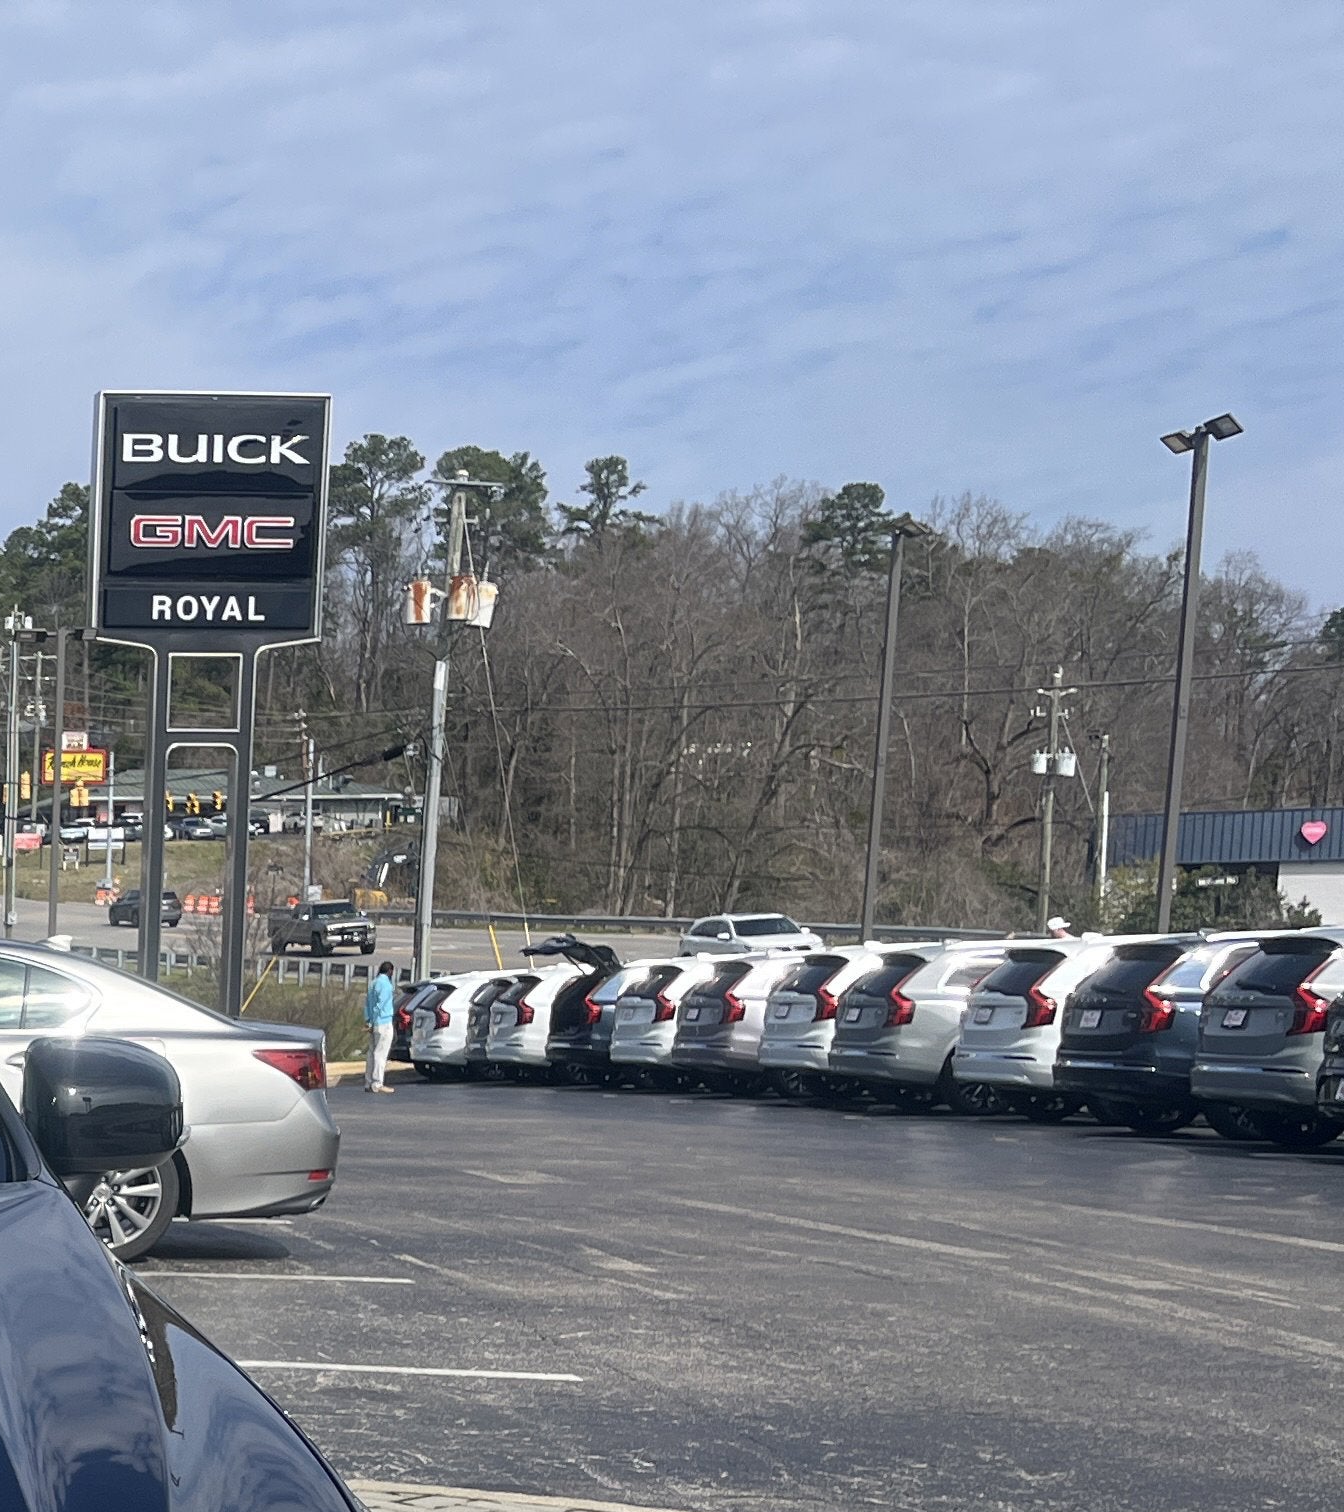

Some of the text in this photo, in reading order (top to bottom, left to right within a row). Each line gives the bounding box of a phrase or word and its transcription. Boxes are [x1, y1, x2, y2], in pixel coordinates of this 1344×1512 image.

[122, 433, 311, 465] BUICK
[130, 514, 295, 549] GMC
[151, 594, 266, 622] ROYAL
